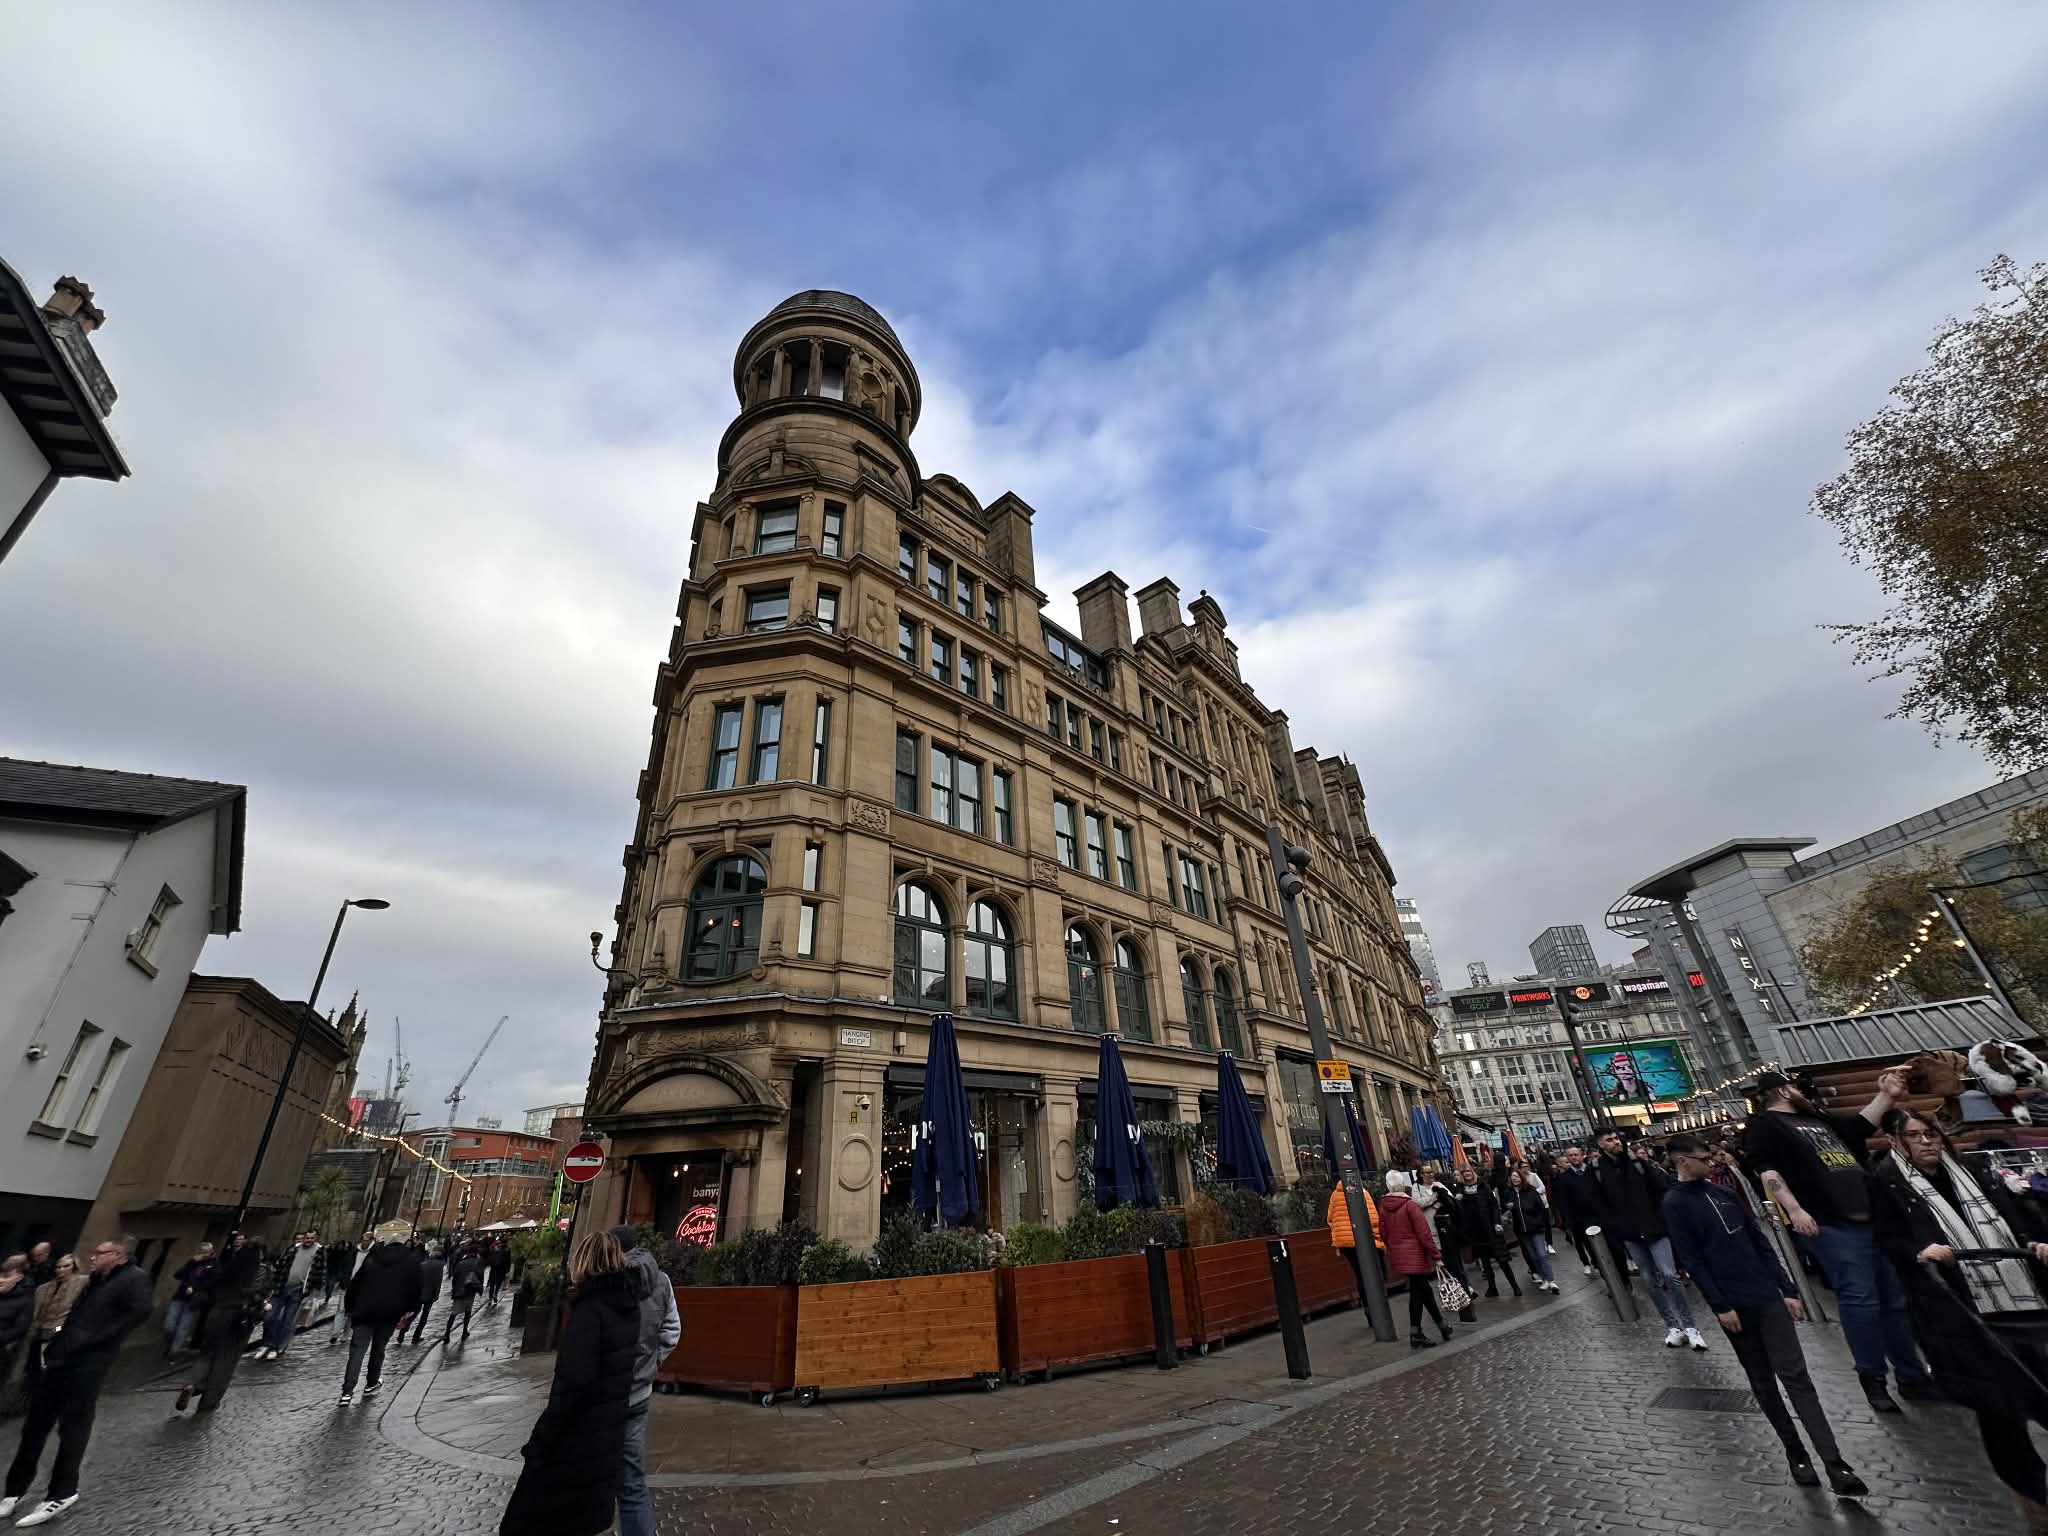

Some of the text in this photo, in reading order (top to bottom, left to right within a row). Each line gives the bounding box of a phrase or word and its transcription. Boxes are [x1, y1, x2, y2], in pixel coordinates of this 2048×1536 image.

[1730, 937, 1769, 1011] NEXT
[1623, 980, 1669, 993] wagamam
[1511, 992, 1551, 1002] PRINTWORKS
